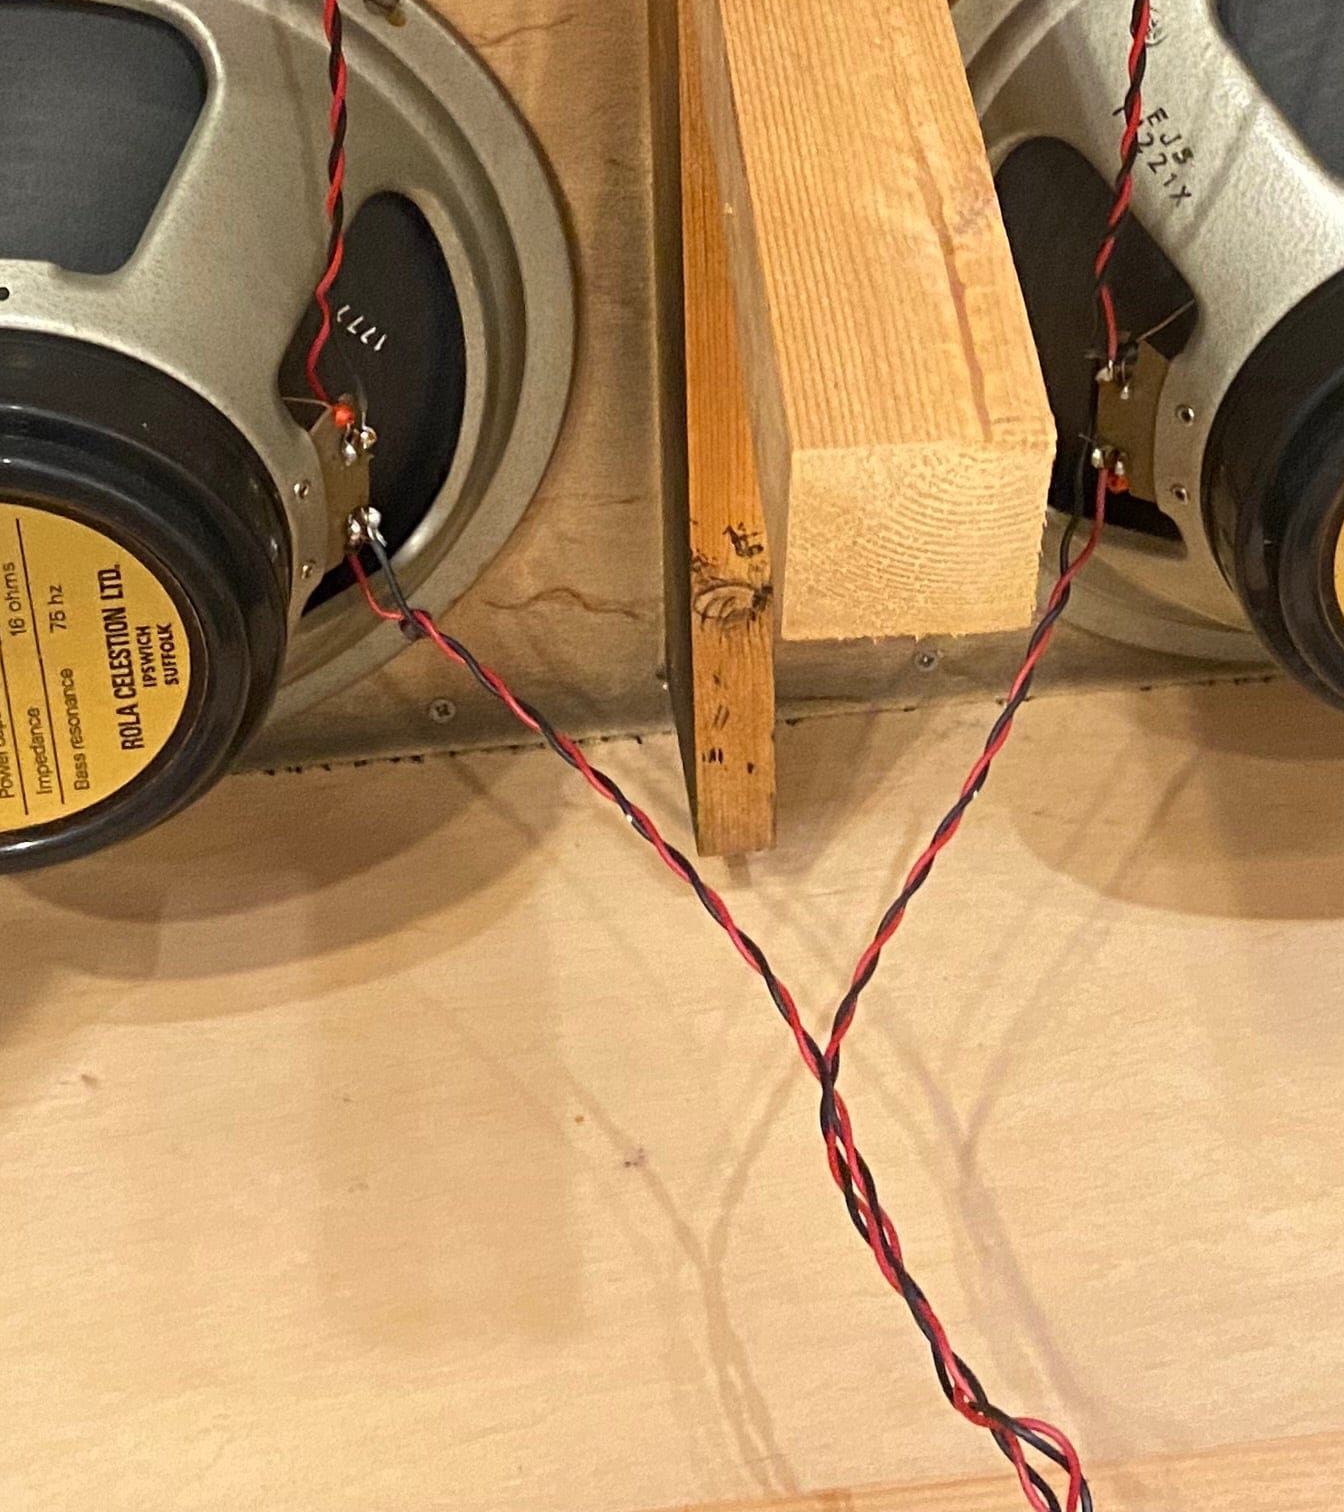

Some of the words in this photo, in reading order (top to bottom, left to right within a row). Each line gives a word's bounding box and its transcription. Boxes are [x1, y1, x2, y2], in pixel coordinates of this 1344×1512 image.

[2, 562, 22, 611] ohms
[49, 585, 66, 605] hz
[98, 563, 124, 601] LTD.
[7, 618, 26, 637] 16
[49, 610, 67, 633] 75
[102, 607, 137, 700] CELESTION
[135, 625, 157, 688] IPSWICH
[156, 623, 180, 685] SUFFOLK
[60, 668, 85, 750] resonance
[115, 703, 145, 751] ROLA
[26, 707, 53, 795] Impedance
[72, 753, 90, 791] Bass
